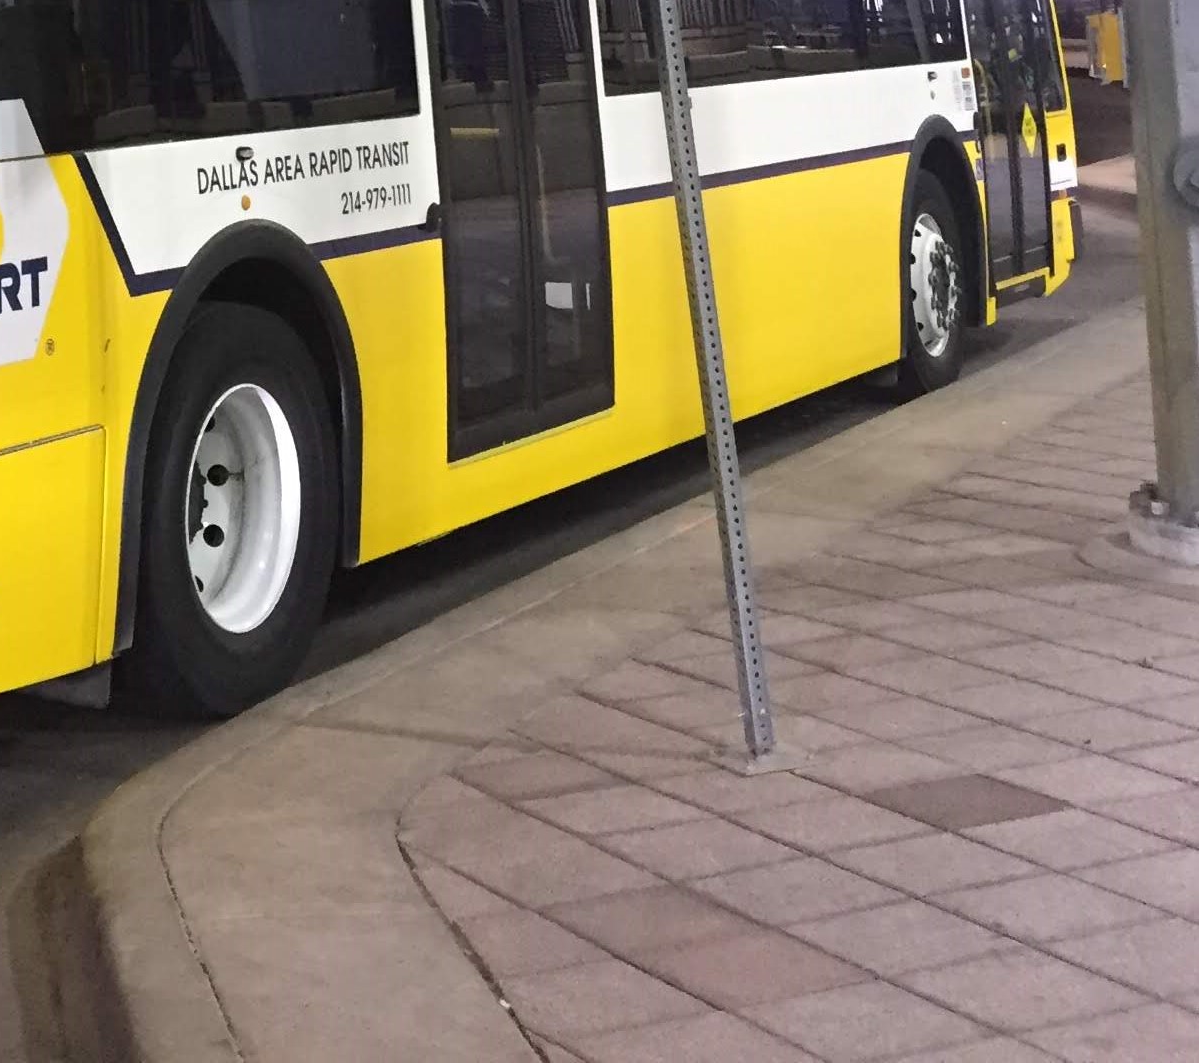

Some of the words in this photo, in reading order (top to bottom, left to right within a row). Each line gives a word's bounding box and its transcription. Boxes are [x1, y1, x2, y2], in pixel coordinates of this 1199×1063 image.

[197, 159, 258, 195] DALLAS
[264, 154, 305, 185] AREA
[309, 147, 352, 178] RAPID
[356, 141, 410, 171] TRANSIT
[340, 183, 412, 215] 214-979-1111
